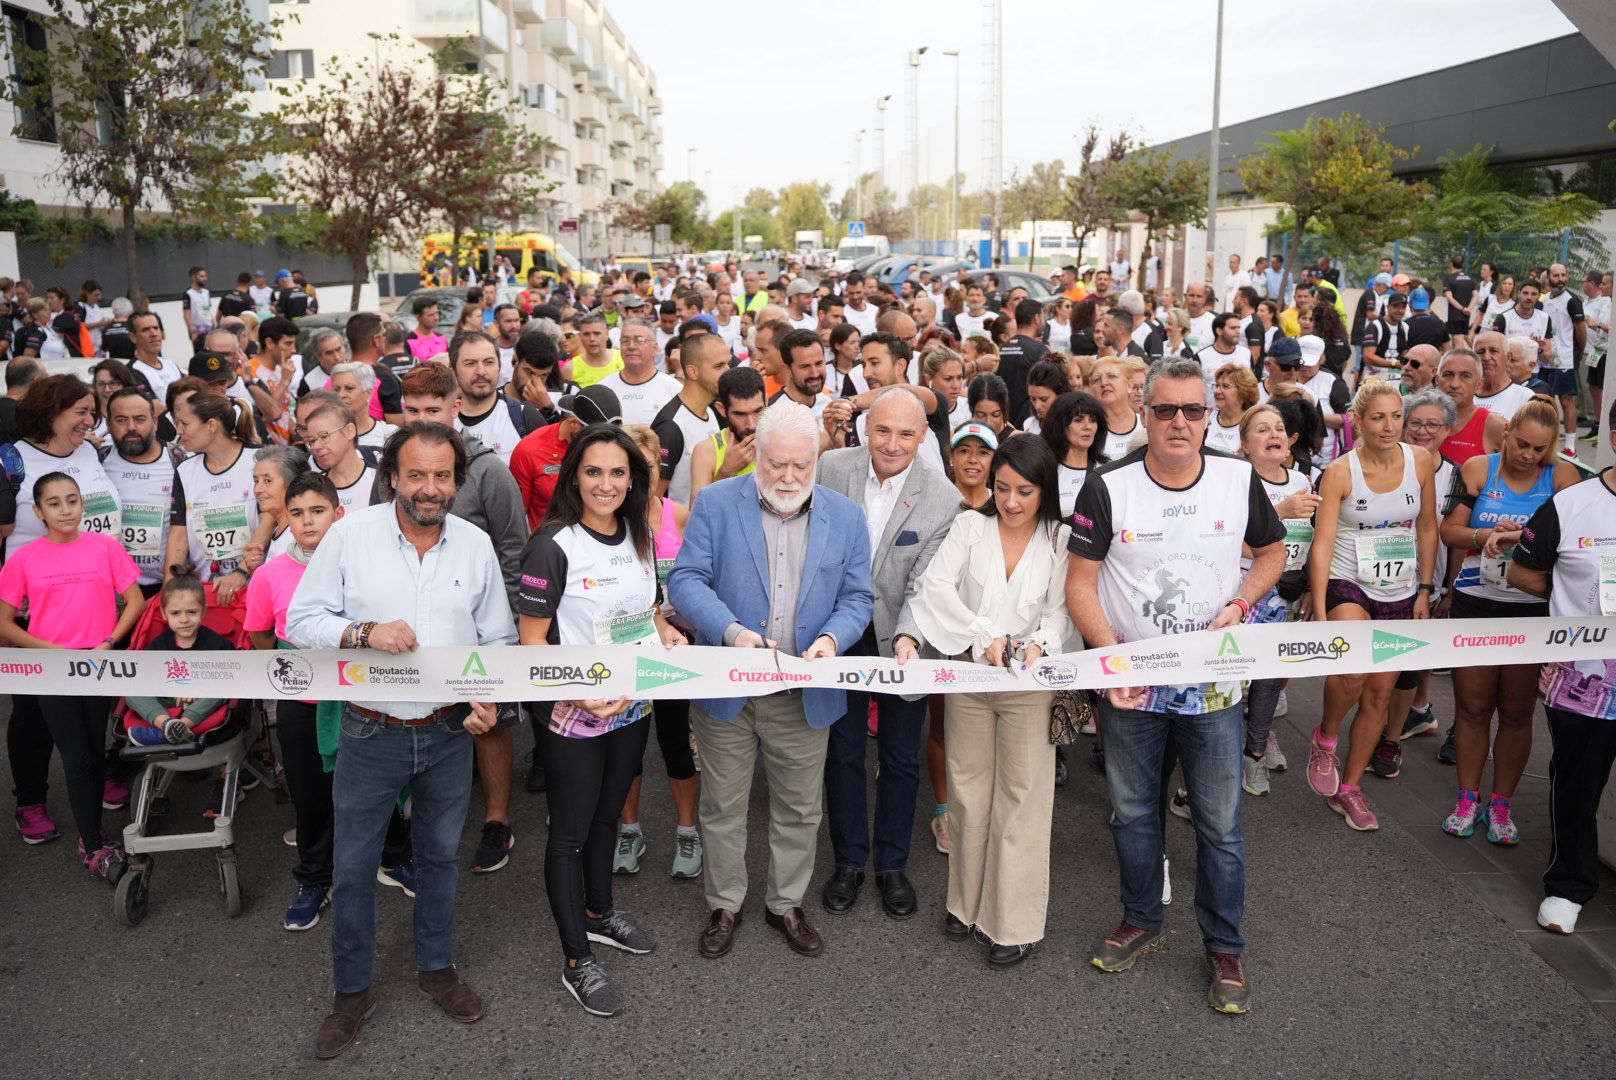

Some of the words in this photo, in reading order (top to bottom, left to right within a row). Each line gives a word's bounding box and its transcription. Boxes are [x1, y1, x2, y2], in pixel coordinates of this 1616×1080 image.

[121, 472, 150, 480] JOYLU
[1162, 504, 1197, 518] JOYLU
[84, 514, 112, 533] 294
[121, 528, 147, 543] 93
[205, 530, 236, 548] 297
[1387, 536, 1413, 545] POPULAR
[1153, 557, 1166, 568] DE
[1167, 552, 1187, 561] ORO
[1190, 553, 1204, 563] DE
[1204, 559, 1215, 570] LA
[1373, 561, 1404, 578] 117
[1587, 581, 1600, 605] MEDA
[1452, 633, 1526, 648] Cruzcampo
[1545, 625, 1608, 647] JOYLU
[1373, 642, 1381, 650] El
[1381, 641, 1395, 650] Corte
[1130, 651, 1180, 662] Diputación
[1204, 658, 1221, 666] Junta
[1221, 657, 1228, 665] de
[1229, 655, 1256, 665] Andalucía
[68, 658, 138, 682] JOYLU
[190, 661, 242, 671] AYUNTAMIENTO
[1132, 662, 1144, 670] de
[1145, 660, 1182, 669] Córdoba
[191, 670, 200, 680] DE
[369, 666, 420, 677] Diputación
[637, 668, 646, 677] El
[646, 669, 662, 677] Corte
[728, 668, 813, 682] Cruzcampo
[282, 676, 309, 687] Peñas
[369, 676, 382, 684] de
[383, 675, 421, 685] Córdoba
[473, 677, 504, 686] Andalucía
[836, 668, 905, 687] JOYLU
[1048, 673, 1074, 682] Peñas
